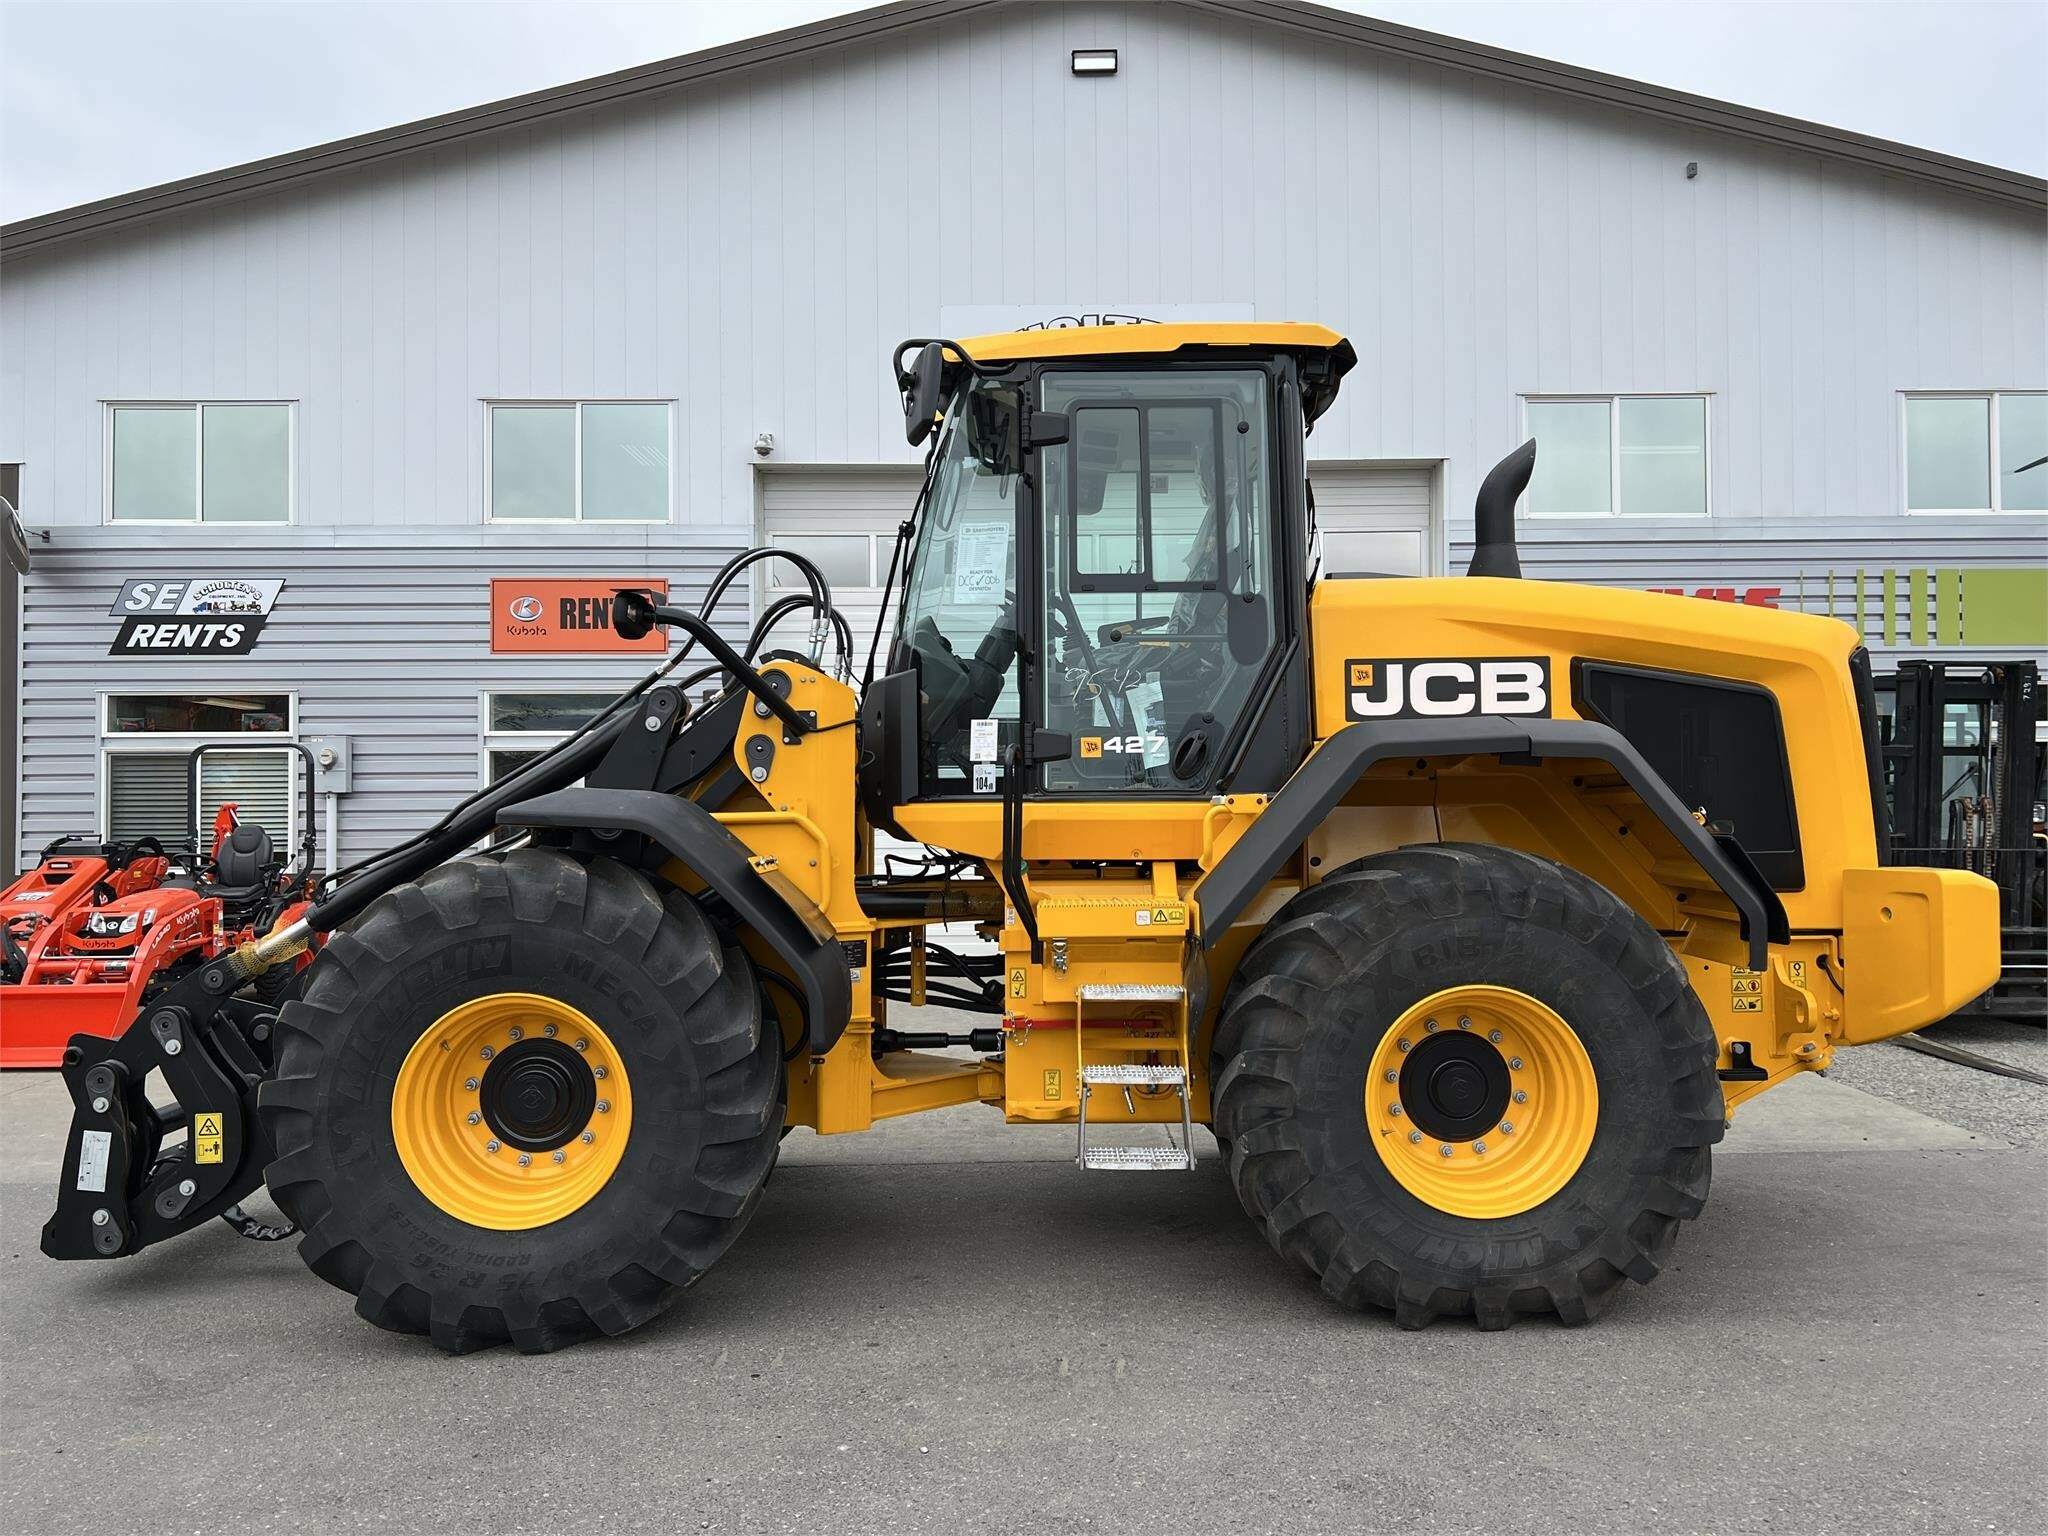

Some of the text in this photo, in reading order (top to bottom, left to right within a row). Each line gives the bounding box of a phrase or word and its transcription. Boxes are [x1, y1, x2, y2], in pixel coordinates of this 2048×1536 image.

[124, 583, 186, 611] SE
[192, 580, 263, 601] SCHOLTEN'S
[126, 623, 245, 648] RENTS
[506, 625, 547, 636] Kubota
[1355, 669, 1371, 681] JCB
[1351, 661, 1547, 716] JCB
[1086, 736, 1166, 754] JCB 427
[975, 776, 989, 791] 104
[176, 907, 200, 925] Kubota
[82, 940, 116, 949] Kubota
